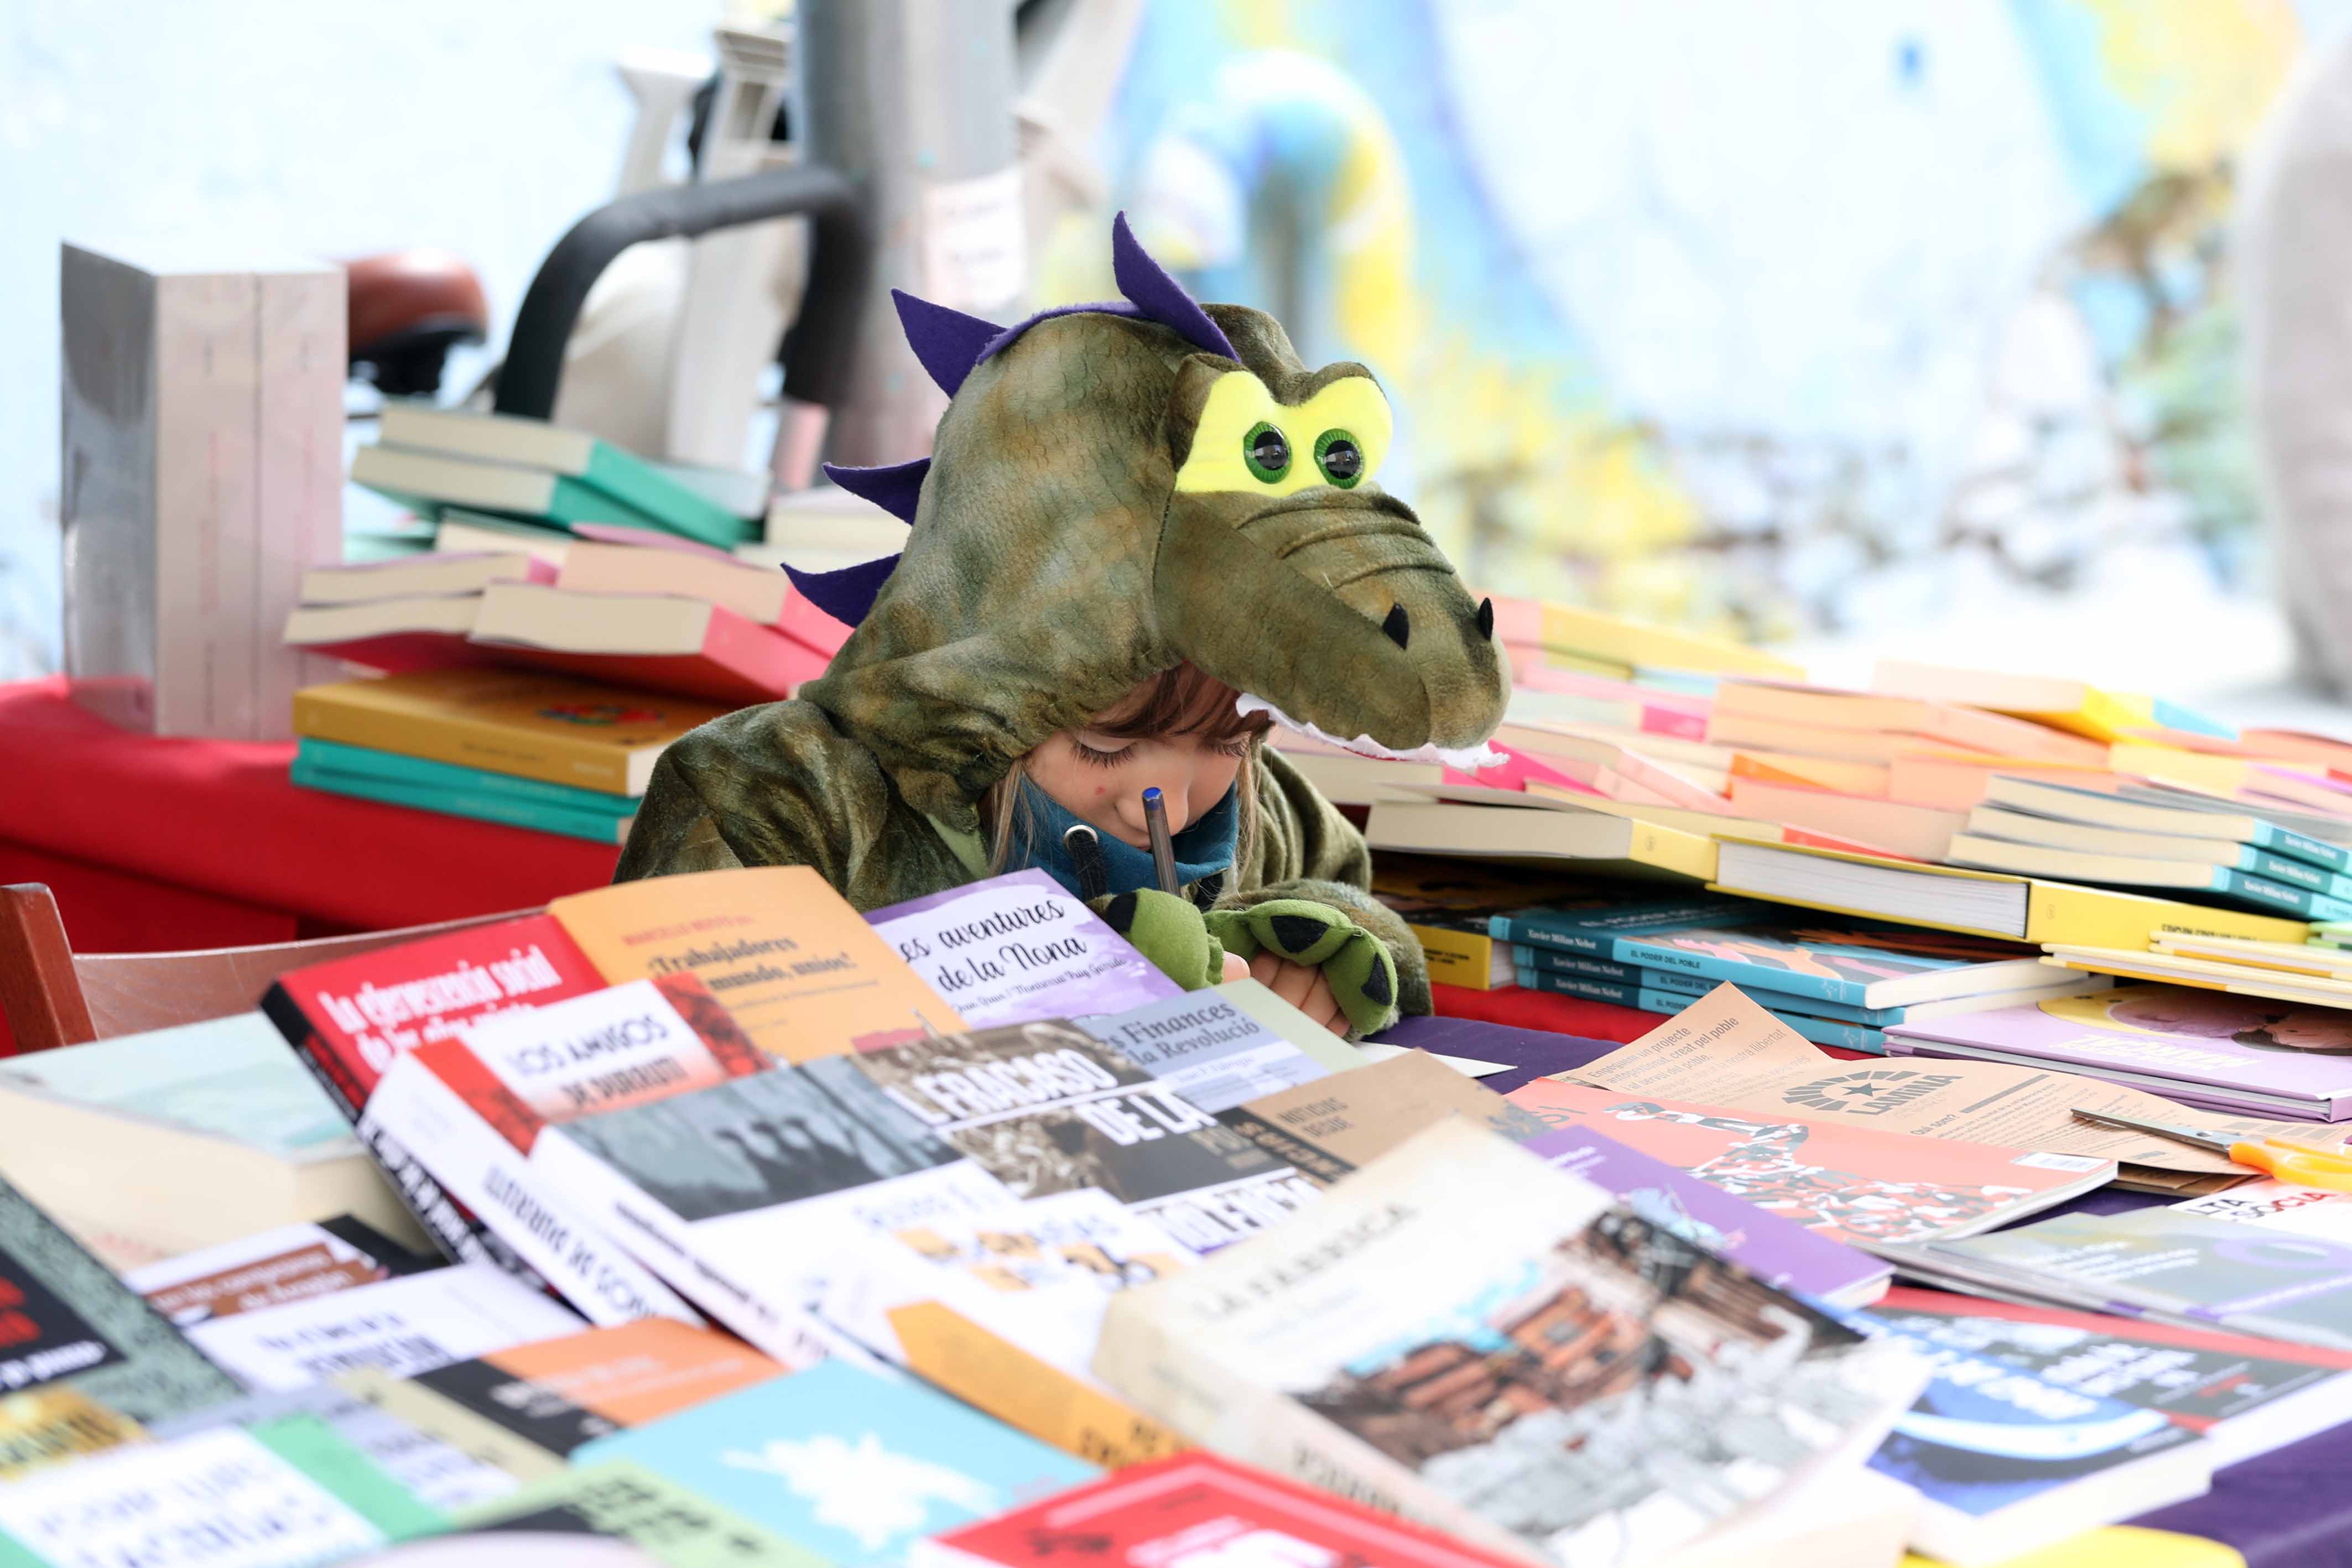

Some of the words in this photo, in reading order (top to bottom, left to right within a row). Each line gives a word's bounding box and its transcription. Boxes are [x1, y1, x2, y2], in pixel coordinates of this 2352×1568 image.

[901, 937, 931, 962] es
[938, 900, 1064, 949] aventures
[1527, 929, 1550, 940] Xavier
[936, 965, 974, 992] de
[966, 957, 1005, 981] la
[998, 936, 1087, 971] Nona
[1630, 950, 1640, 958] EL
[1641, 951, 1663, 962] PODER
[1664, 955, 1678, 965] DEL
[1678, 958, 1700, 970] POBLE
[1669, 977, 1693, 988] PODER
[1694, 981, 1708, 991] DEL
[1119, 1002, 1237, 1044] Finances
[1128, 1049, 1161, 1065] la
[1153, 1018, 1260, 1059] Revolució
[1669, 1041, 1697, 1059] creat
[1694, 1033, 1714, 1049] pel
[1709, 1018, 1740, 1040] poble
[1586, 1054, 1639, 1078] Engeguem
[1651, 1027, 1692, 1053] projecte
[1724, 1046, 1755, 1066] nostra
[1749, 1028, 1786, 1055] llibertat
[913, 1048, 1118, 1120] FRACASO
[1074, 1097, 1165, 1146] DE
[1127, 1086, 1218, 1135] LA
